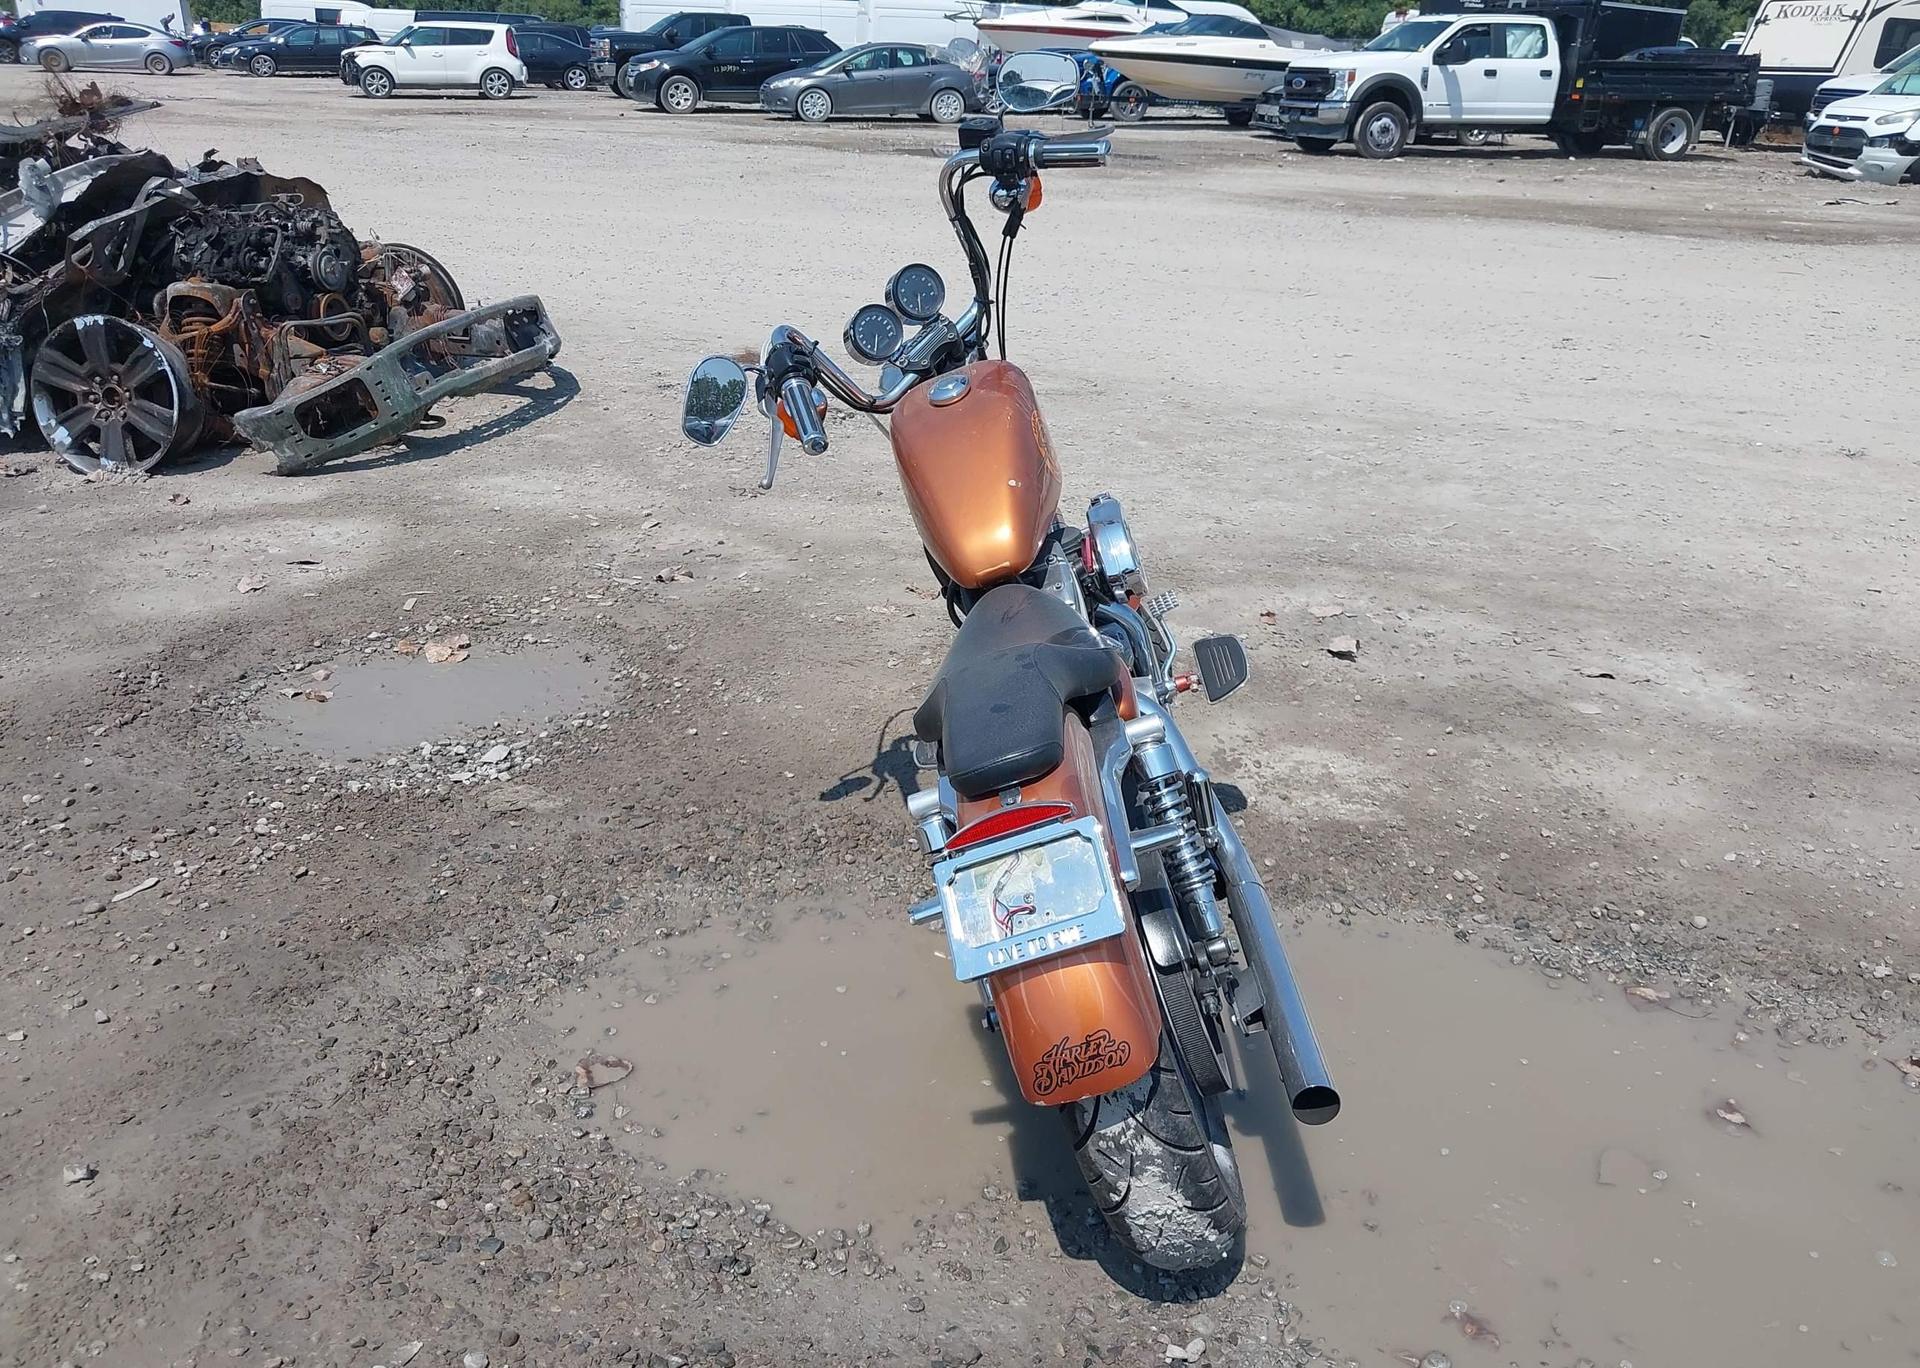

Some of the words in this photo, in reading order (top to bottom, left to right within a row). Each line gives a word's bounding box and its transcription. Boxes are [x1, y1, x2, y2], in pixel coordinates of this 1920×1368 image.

[1776, 4, 1847, 18] KODIAK
[988, 942, 1025, 966] LIVE
[1027, 935, 1047, 955] TO
[1033, 1041, 1131, 1096] DAVIDSON
